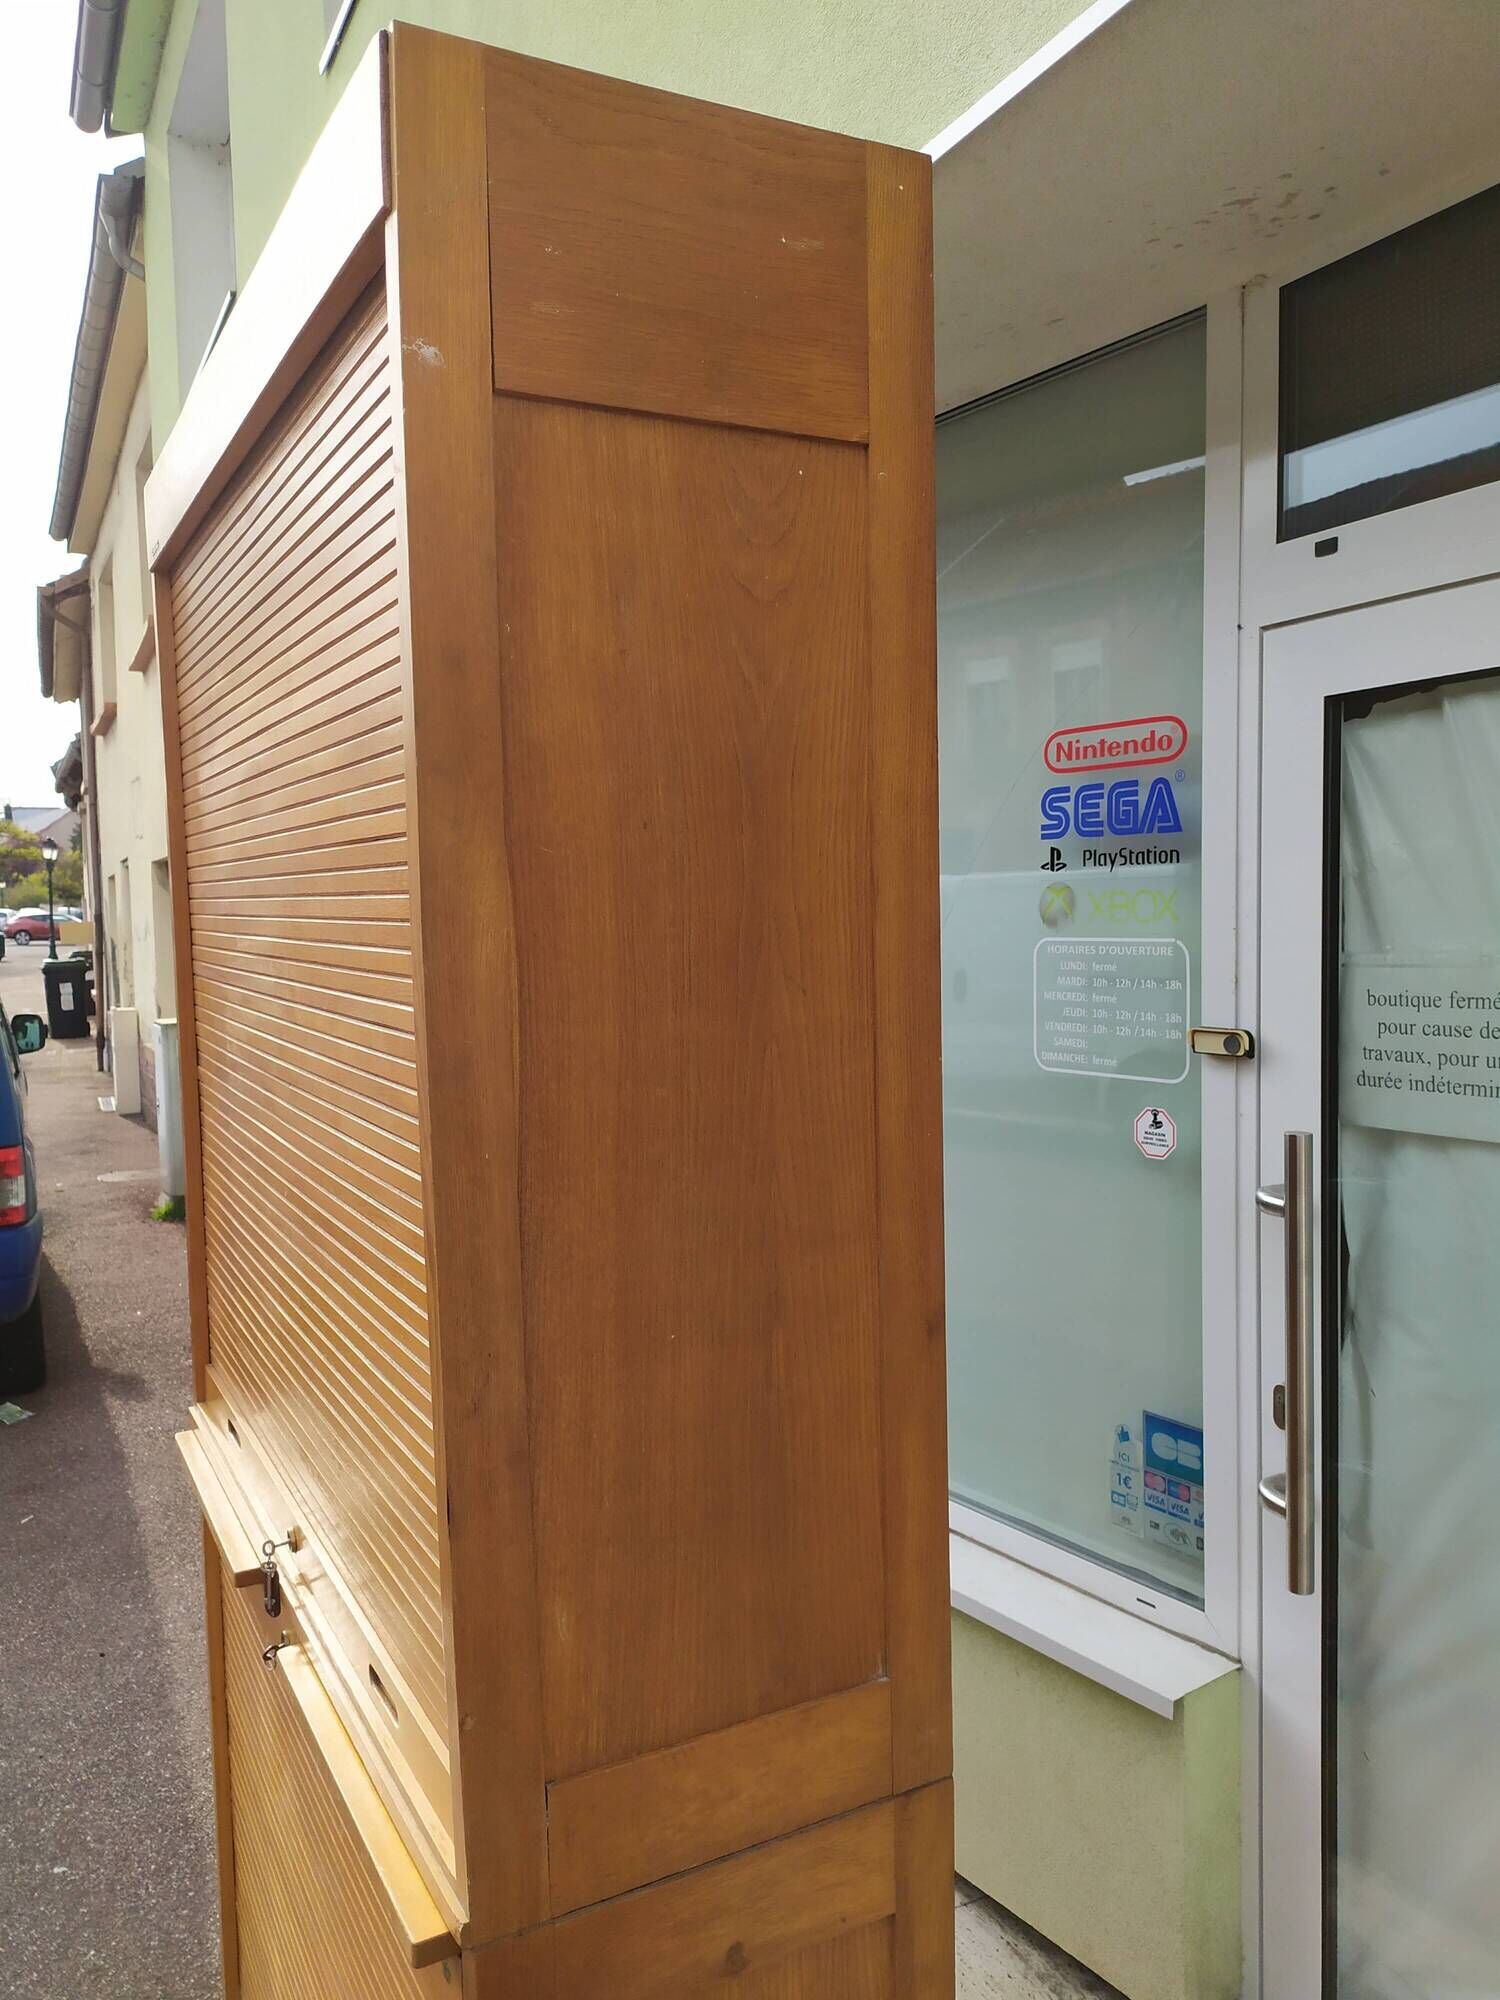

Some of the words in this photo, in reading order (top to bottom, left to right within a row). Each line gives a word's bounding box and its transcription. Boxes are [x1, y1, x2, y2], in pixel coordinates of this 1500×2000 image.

[1055, 730, 1173, 763] Nintendo
[1040, 777, 1183, 840] SEGA
[1082, 846, 1180, 872] PlayStation
[1087, 887, 1180, 925] XBOX
[1047, 944, 1096, 955] HORAIRES
[1099, 945, 1174, 957] D'OUVERTURE
[1060, 961, 1088, 971] LUNDI:
[1115, 978, 1131, 989] 12h
[1141, 979, 1157, 990] 14h
[1165, 980, 1182, 991] 18h
[1367, 988, 1442, 1012] boutique
[1062, 1007, 1088, 1017] JEUDI:
[1115, 1010, 1131, 1021] 12h
[1141, 1011, 1157, 1022] 14h
[1165, 1012, 1182, 1023] 18h
[1115, 1026, 1131, 1037] 12h
[1141, 1027, 1157, 1038] 14h
[1165, 1029, 1182, 1040] 18h
[1377, 1021, 1417, 1039] pour
[1422, 1023, 1473, 1039] cause
[1479, 1020, 1500, 1040] de
[1362, 1045, 1432, 1067] travaux,
[1438, 1051, 1480, 1070] pour
[1486, 1055, 1500, 1069] u
[1356, 1069, 1402, 1090] durée
[1116, 1472, 1132, 1489] 1€
[1146, 1493, 1165, 1505] VISA
[1170, 1502, 1190, 1515] VISA
